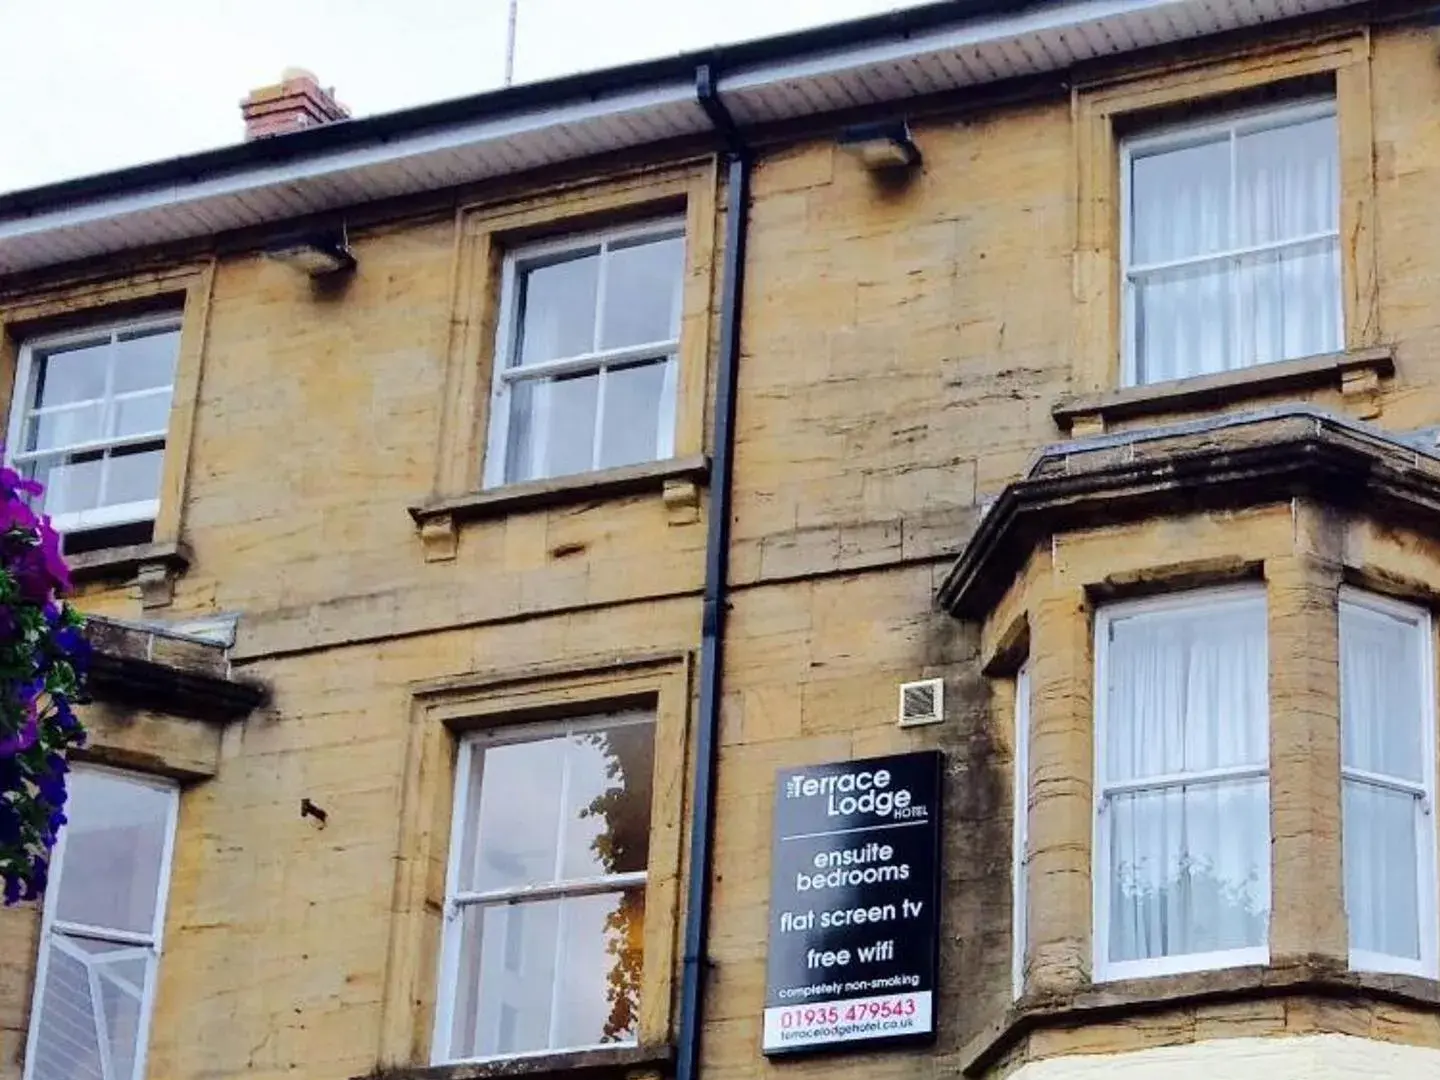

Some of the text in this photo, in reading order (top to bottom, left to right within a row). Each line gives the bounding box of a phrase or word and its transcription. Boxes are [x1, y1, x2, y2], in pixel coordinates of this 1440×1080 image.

[792, 769, 891, 798] Terrace
[828, 789, 928, 819] Lodge HOTEL
[814, 843, 894, 868] ensuite
[796, 863, 910, 892] bedrooms
[780, 898, 922, 932] flat screen tv
[807, 940, 894, 969] free wifi
[778, 974, 920, 998] completely non-smoking
[781, 998, 916, 1029] 01935 479543
[781, 1019, 914, 1041] terracelodgehotel.co.uk
